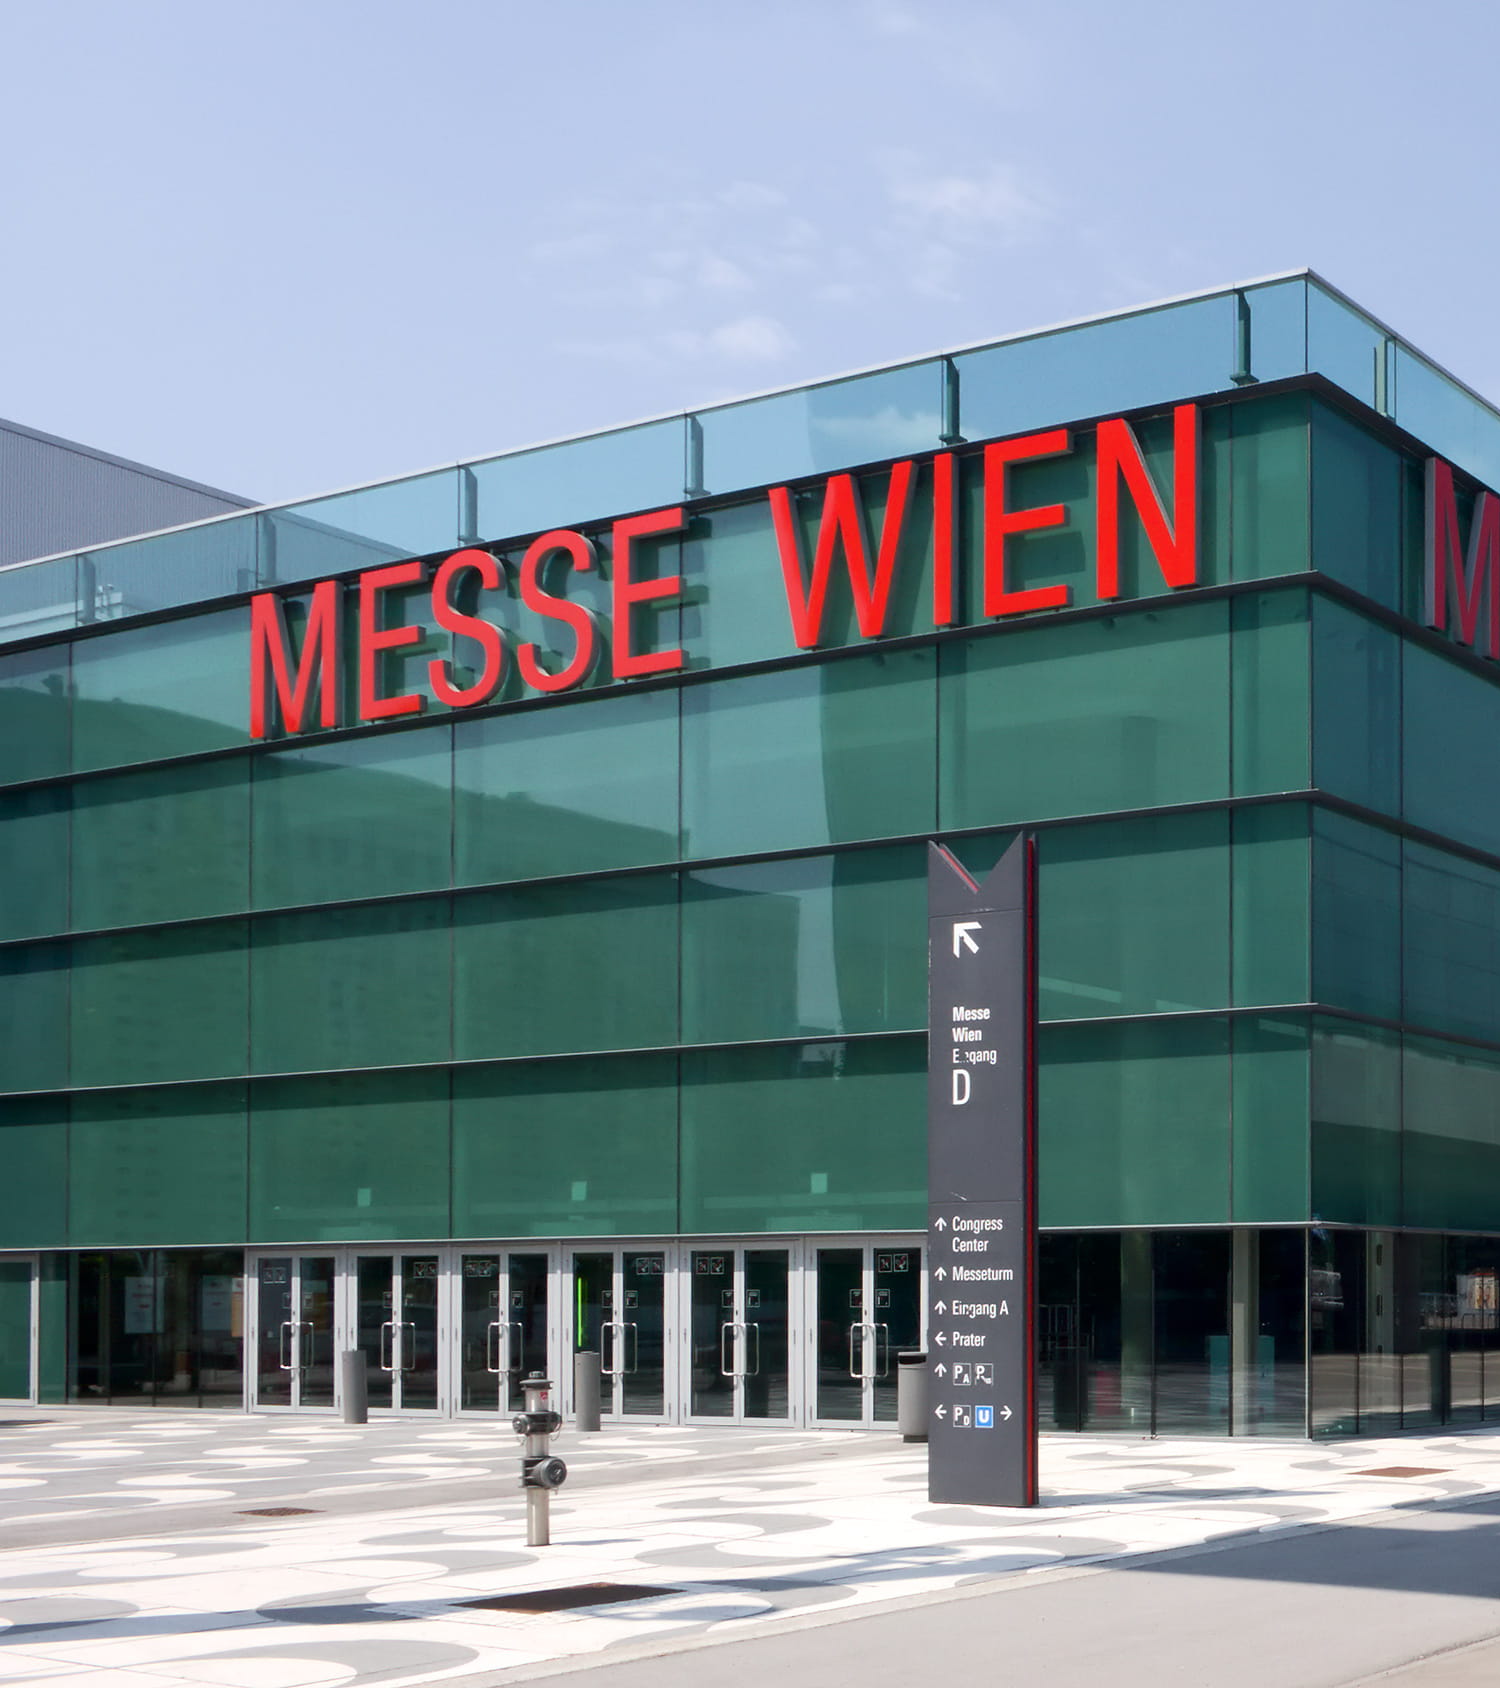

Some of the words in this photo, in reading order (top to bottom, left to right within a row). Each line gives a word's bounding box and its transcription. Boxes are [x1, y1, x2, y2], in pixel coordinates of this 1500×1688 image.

[250, 507, 688, 740] MESSE
[769, 403, 1199, 650] WIEN
[952, 1006, 990, 1022] Messe
[952, 1027, 982, 1042] Wien
[952, 1068, 971, 1105] D
[952, 1215, 1003, 1235] Congress
[952, 1236, 989, 1253] Center
[952, 1265, 1014, 1281] Messeturm
[999, 1300, 1009, 1315] A
[952, 1331, 986, 1347] Prater
